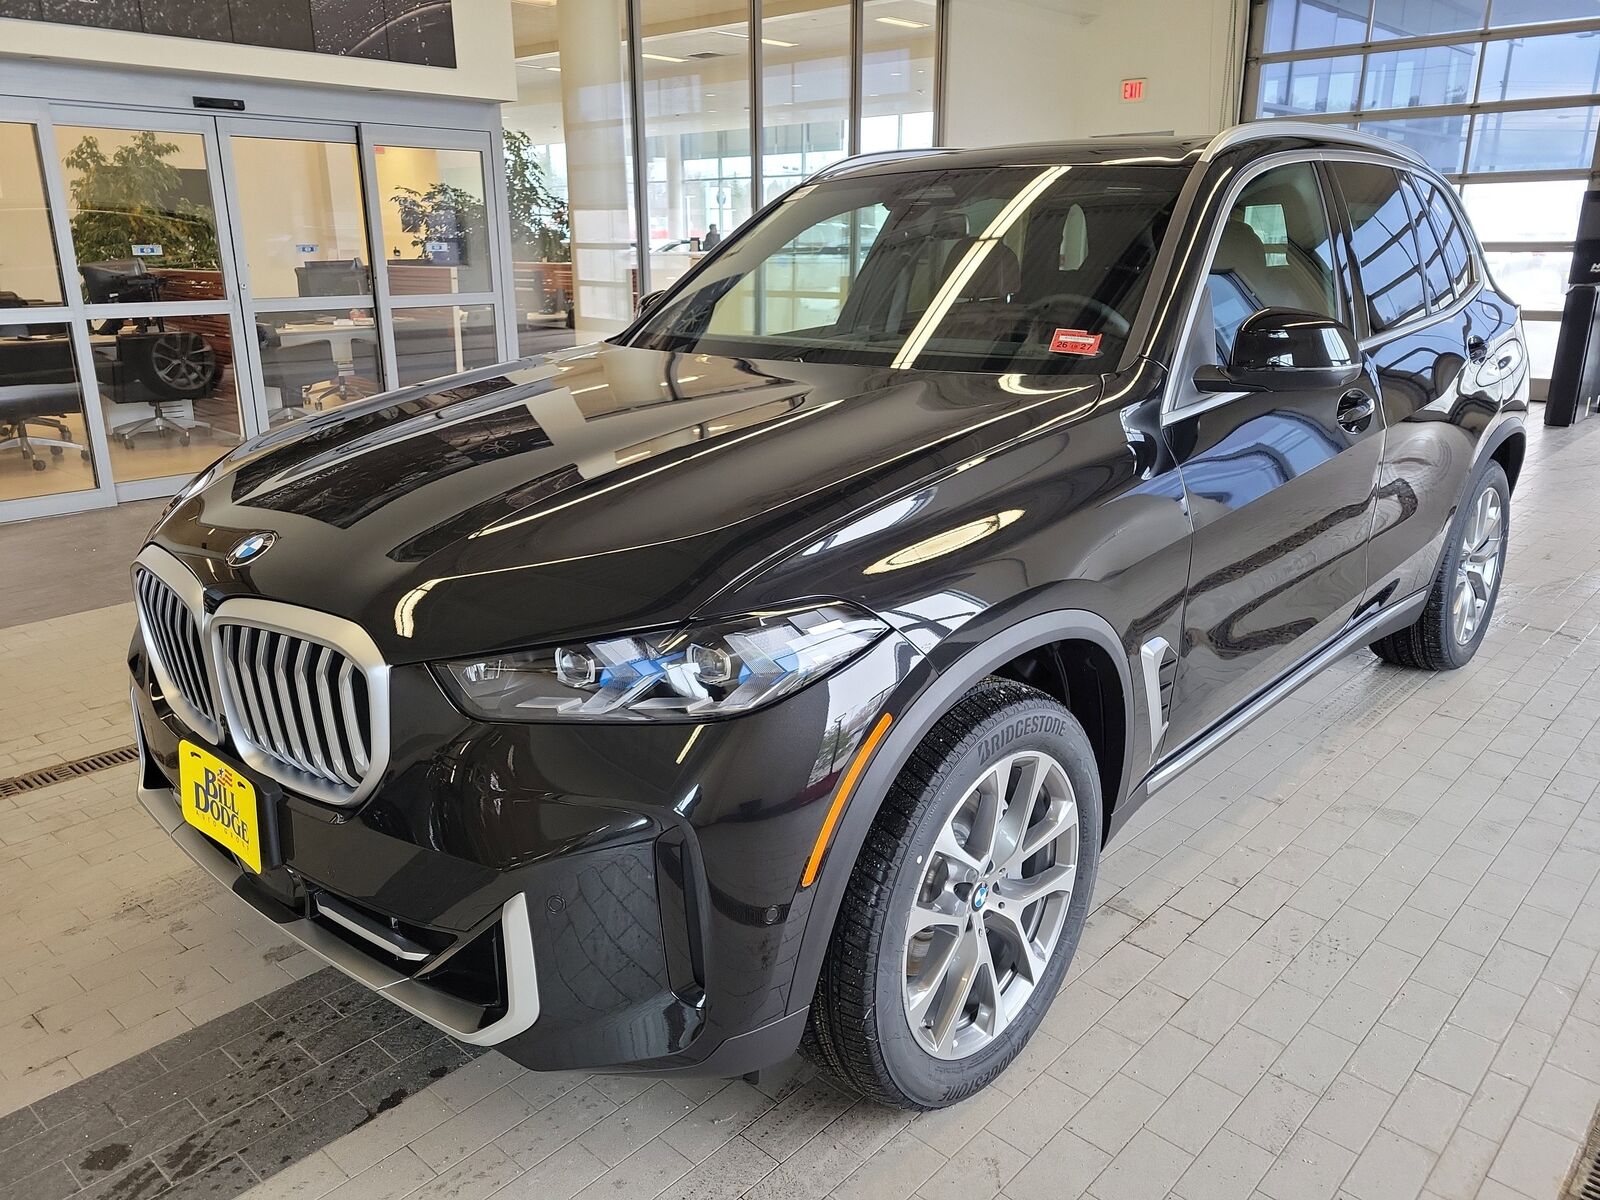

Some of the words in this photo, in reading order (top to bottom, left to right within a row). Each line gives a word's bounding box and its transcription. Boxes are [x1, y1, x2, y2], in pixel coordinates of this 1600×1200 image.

[1124, 82, 1142, 99] EXIT
[978, 716, 1067, 766] BRIDGESTONE
[194, 781, 250, 844] DODGE
[204, 767, 239, 815] BILL
